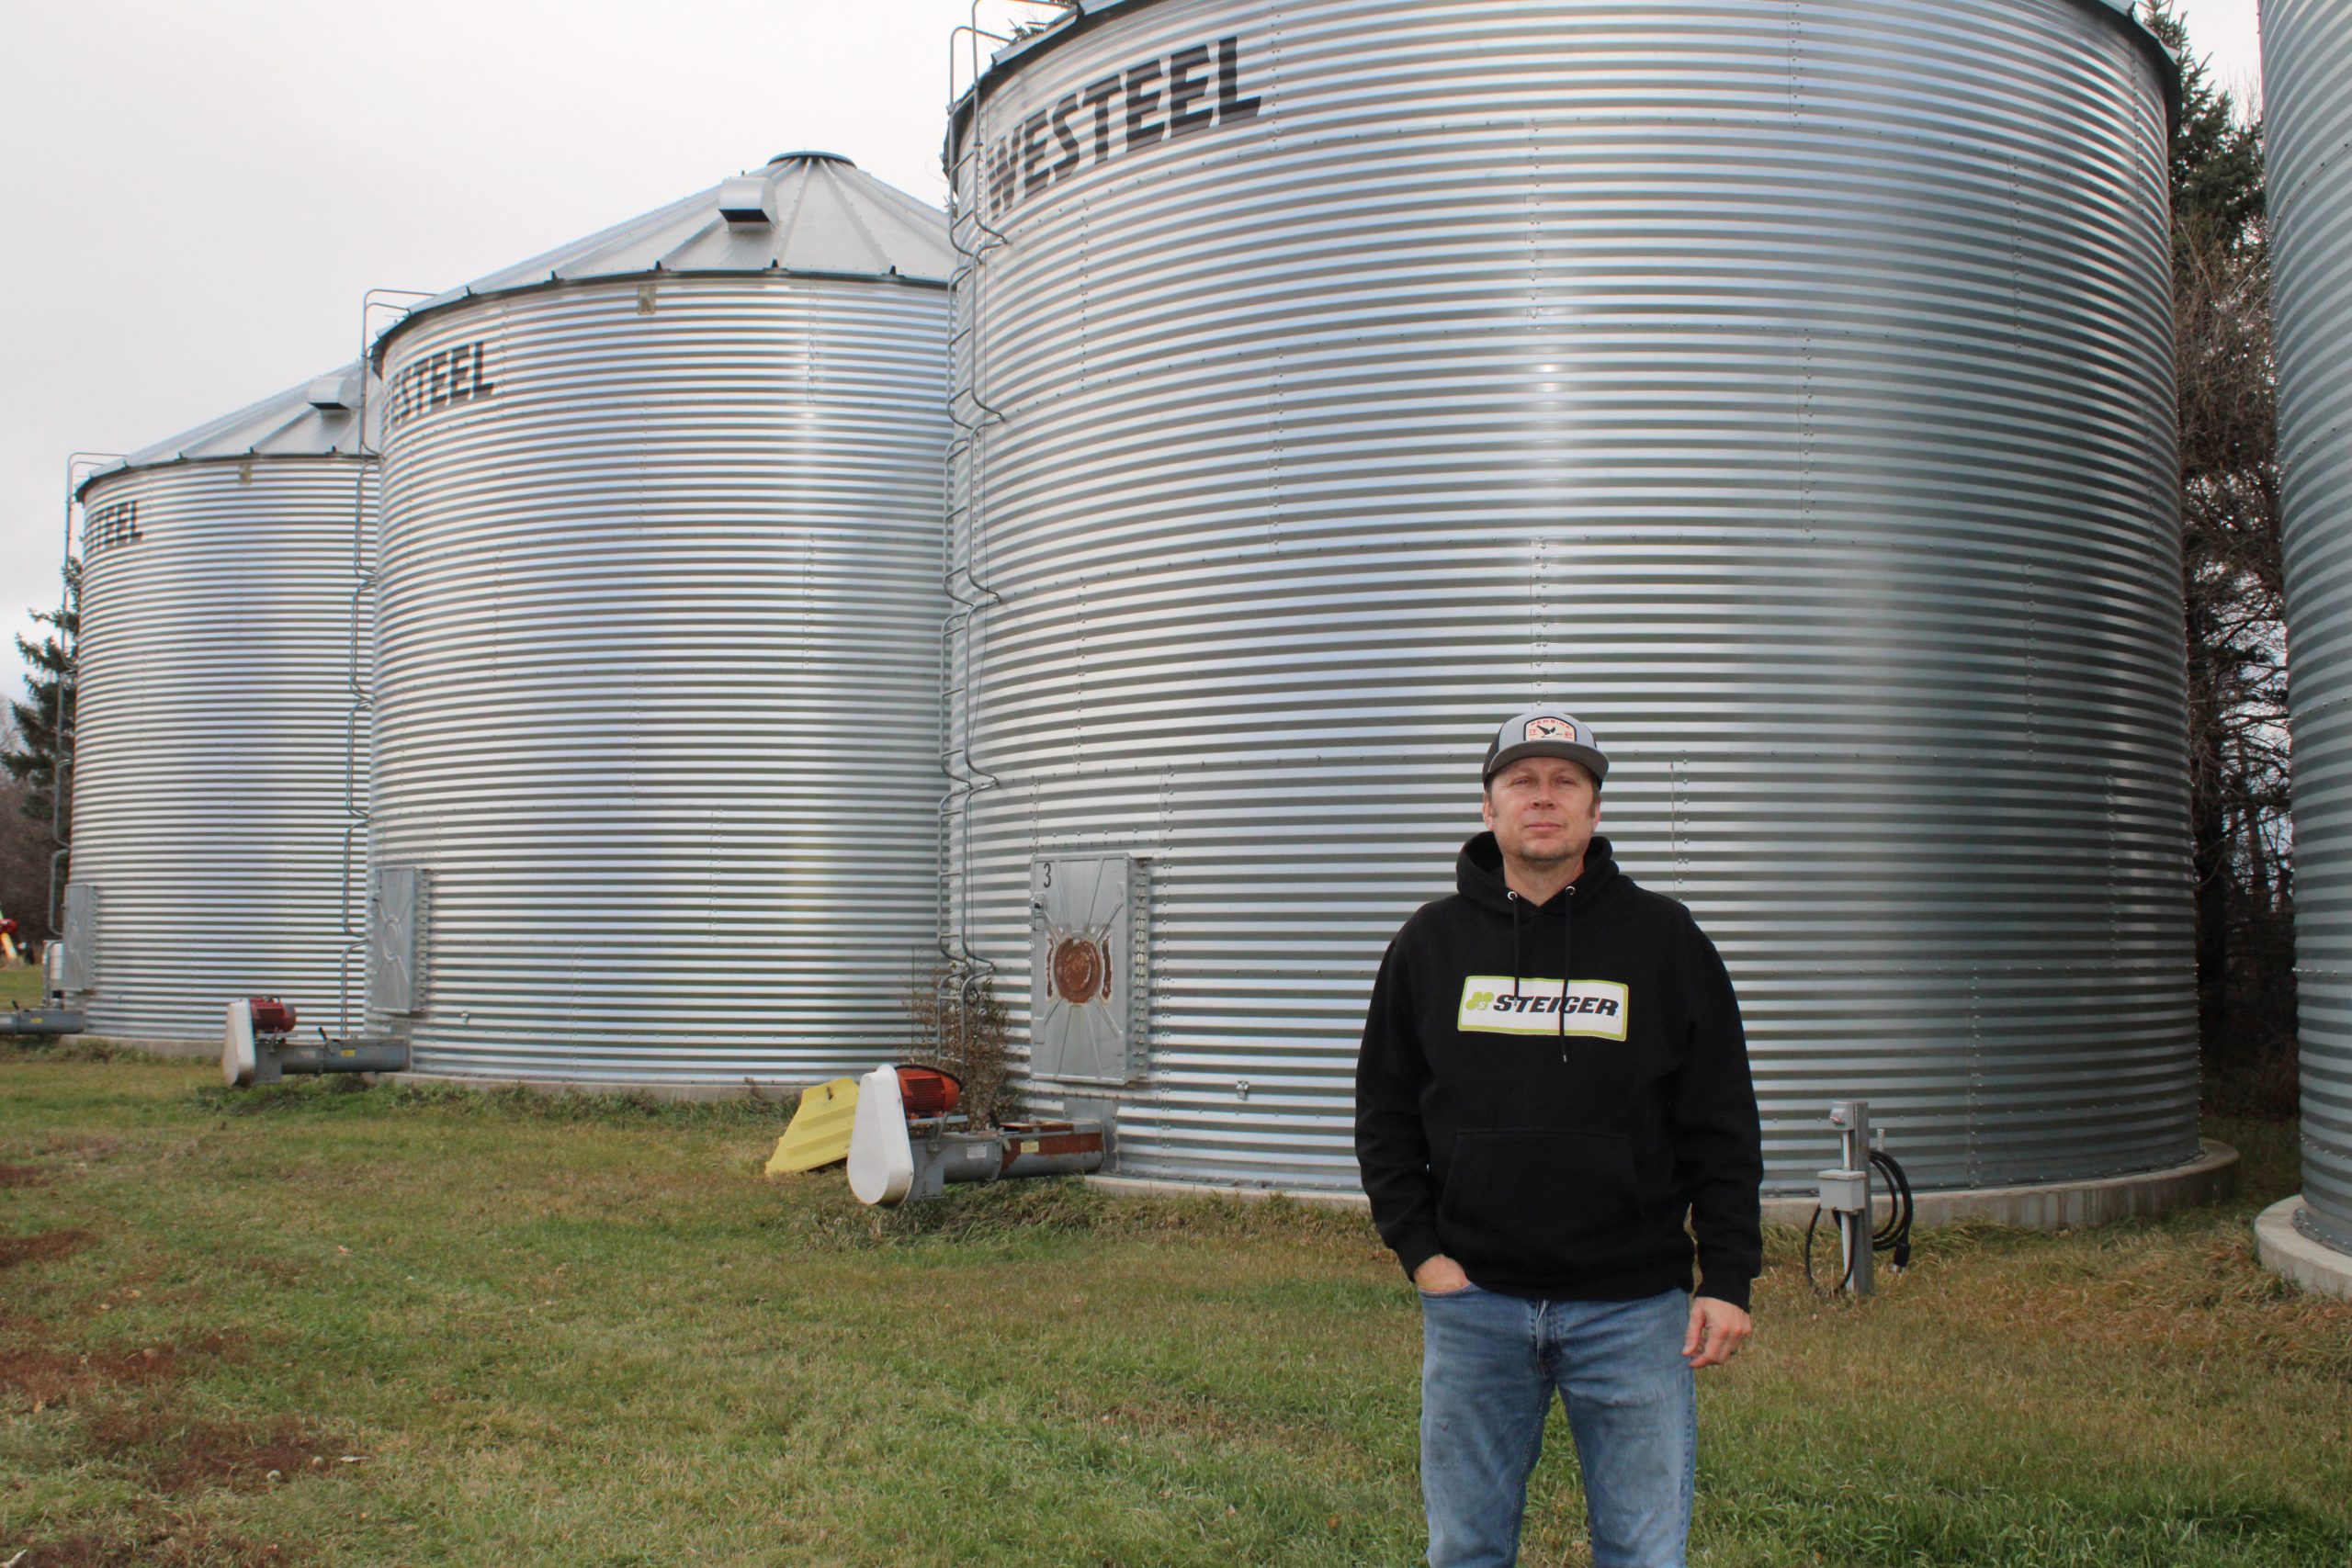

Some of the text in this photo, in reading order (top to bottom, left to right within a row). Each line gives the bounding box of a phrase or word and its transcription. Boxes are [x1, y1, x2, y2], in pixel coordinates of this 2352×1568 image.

[987, 36, 1261, 220] WESTEEL
[1043, 862, 1052, 888] 3
[1493, 994, 1619, 1017] STEIGER
